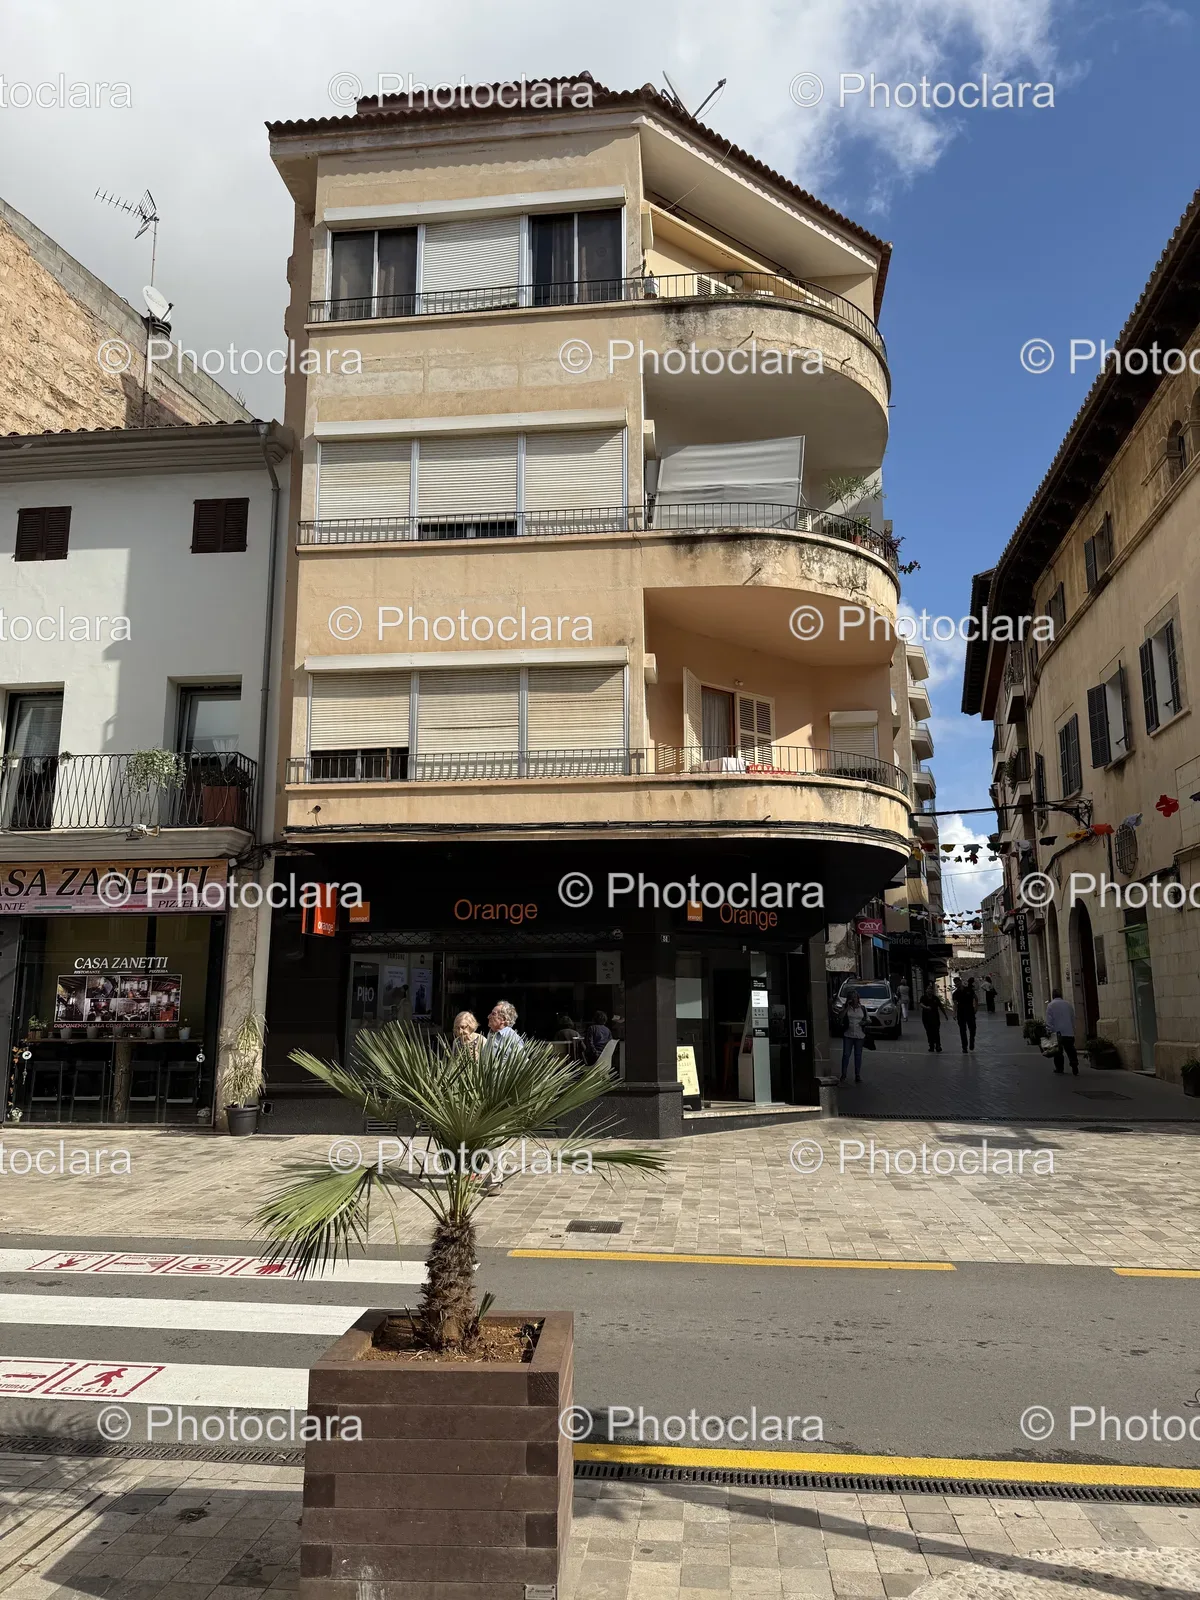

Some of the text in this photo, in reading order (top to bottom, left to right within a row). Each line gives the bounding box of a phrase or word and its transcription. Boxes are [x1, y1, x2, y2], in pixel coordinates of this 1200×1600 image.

[0, 866, 211, 897] SA ZANETTI
[454, 899, 538, 925] Orange
[719, 902, 778, 931] Orange
[317, 921, 334, 934] orange
[858, 921, 881, 931] CATY
[74, 956, 169, 969] CASA ZANETTI
